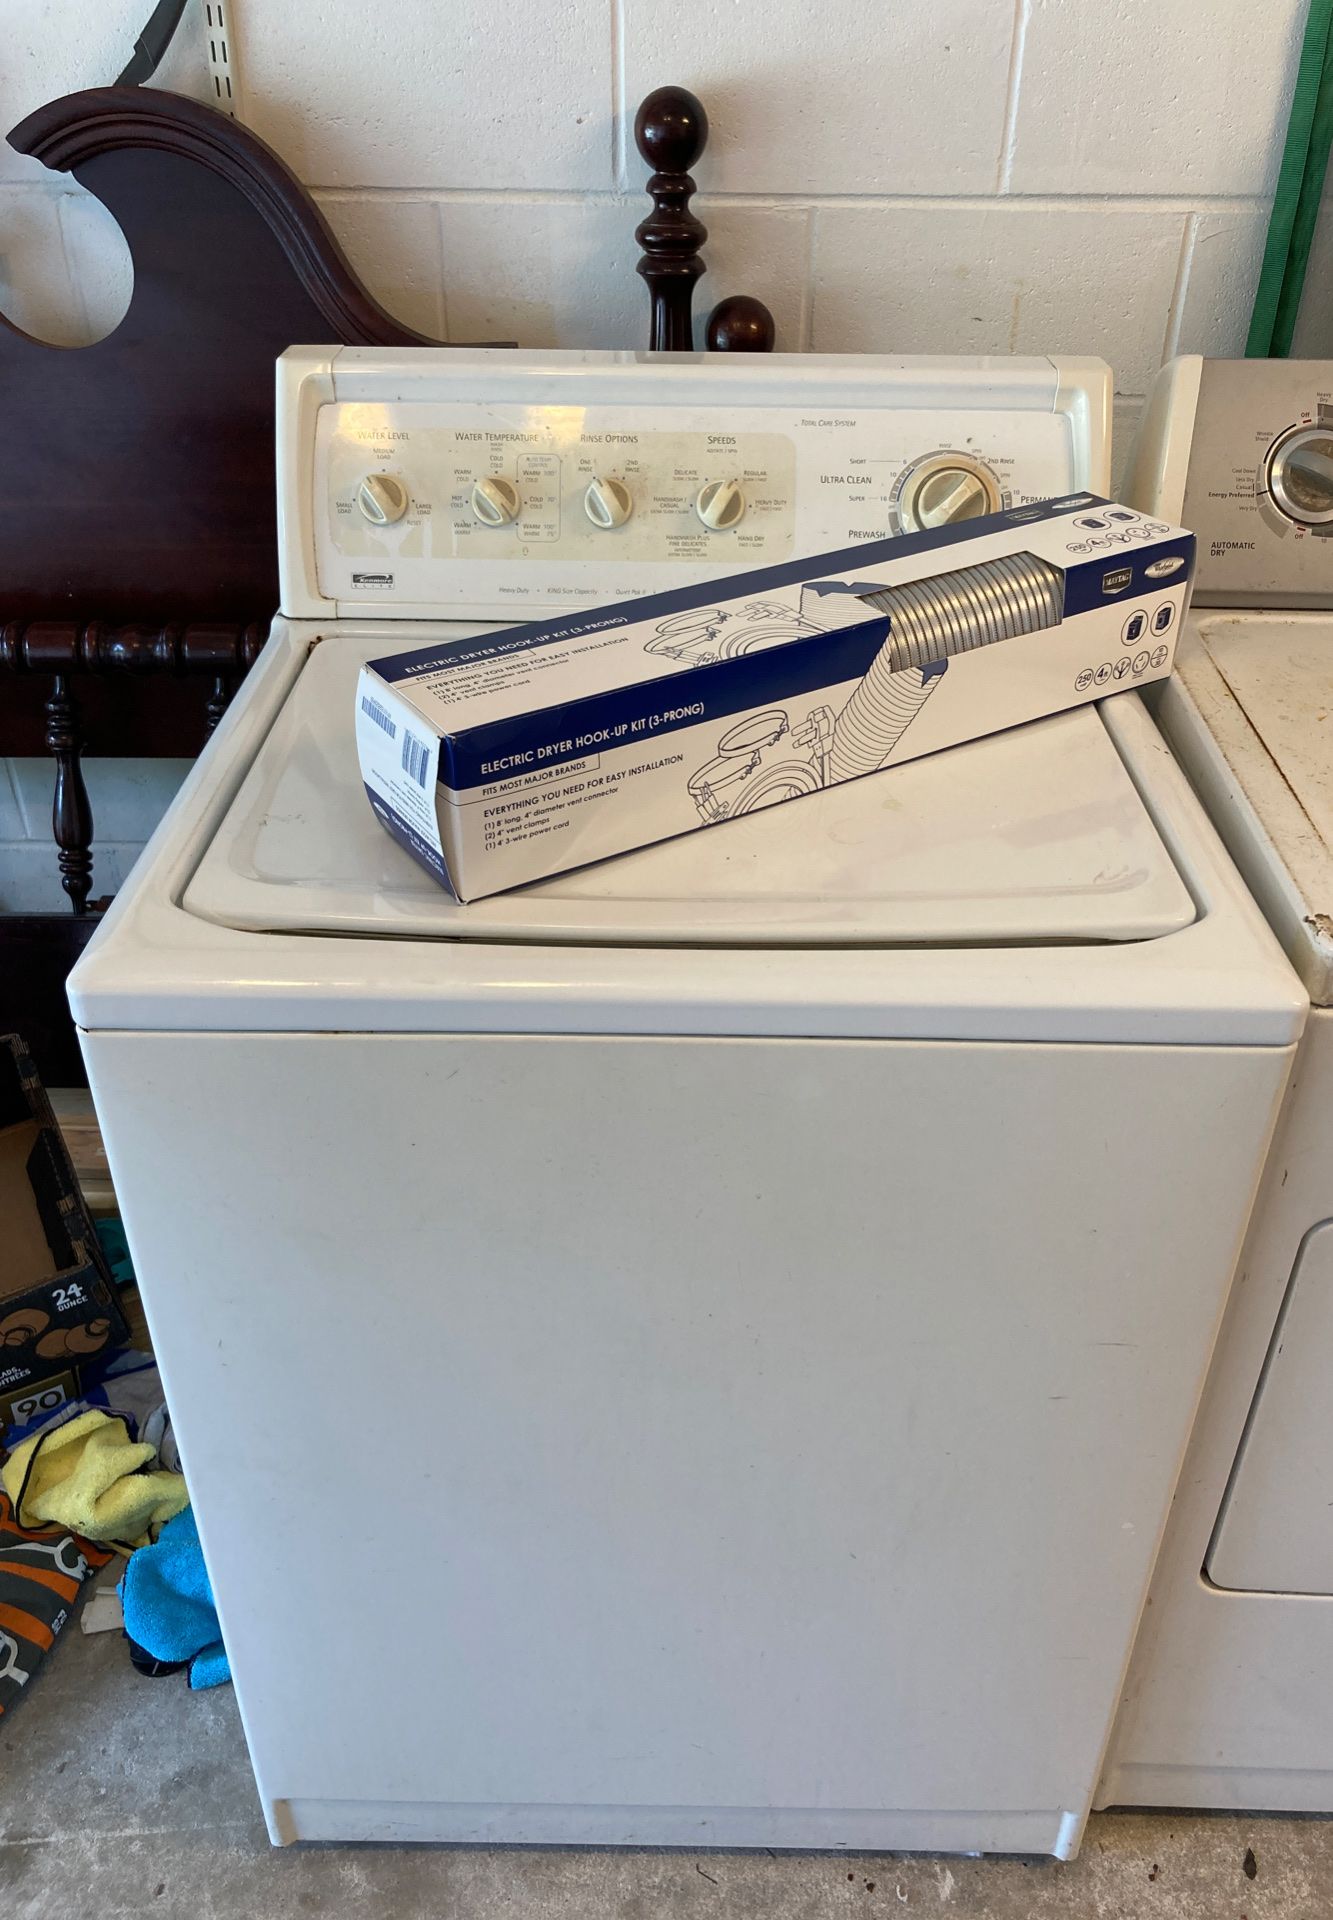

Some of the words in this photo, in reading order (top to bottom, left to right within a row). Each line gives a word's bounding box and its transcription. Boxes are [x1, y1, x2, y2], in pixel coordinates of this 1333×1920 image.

[358, 432, 386, 440] WATER
[388, 432, 410, 440] LEVEL
[455, 432, 483, 441] WATER
[485, 432, 539, 442] TEMPERATURE
[580, 434, 603, 443] RINSE
[605, 434, 639, 443] OPTIONS
[707, 435, 736, 444] SPEEDS
[820, 475, 845, 484] ULTRA
[846, 475, 872, 484] CLEAN
[1021, 495, 1055, 504] PERMA
[848, 529, 886, 539] PREWASH
[1210, 541, 1255, 550] AUTOMATIC
[1210, 549, 1226, 557] DRY
[1106, 572, 1129, 586] MAYTAG
[404, 657, 459, 673] ELECTRIC
[459, 648, 497, 660] DRYER
[498, 635, 551, 651] HOOK-UP
[552, 630, 569, 638] KIT
[570, 616, 628, 635] (3-PRONG)
[426, 673, 482, 690] EVERYTHING
[483, 668, 504, 676] YOU
[505, 662, 529, 671] NEED
[530, 657, 548, 665] FOR
[549, 652, 570, 660] EASY
[571, 637, 629, 654] INSTALLATION
[433, 669, 456, 677] MOST
[457, 663, 486, 672] MAJOR
[487, 654, 520, 665] BRANDS
[483, 672, 515, 683] diameter
[533, 659, 569, 671] connector
[477, 681, 505, 690] clamps
[488, 684, 512, 694] power
[513, 679, 531, 687] cord
[1078, 673, 1092, 685] 250
[481, 751, 534, 774] ELECTRIC
[537, 739, 573, 759] DRYER
[575, 724, 628, 748] HOOK-UP
[631, 718, 647, 732] KIT
[648, 702, 705, 730] (3-PRONG)
[482, 786, 498, 796] FITS
[499, 779, 522, 792] MOST
[524, 771, 554, 786] MAJOR
[555, 761, 587, 777] BRANDS
[484, 796, 539, 818] EVERYTHING
[541, 790, 561, 802] YOU
[563, 783, 585, 796] NEED
[587, 777, 604, 789] FOR
[606, 771, 627, 784] EASY
[628, 754, 684, 777] INSTALLATION
[484, 821, 495, 831] (1)
[533, 803, 566, 817] diameter
[567, 796, 583, 806] vent
[583, 787, 619, 802] connector
[484, 832, 496, 841] (2)
[506, 825, 523, 834] vent
[523, 817, 550, 829] clamps
[485, 842, 496, 851] (1)
[505, 833, 527, 845] 3-wire
[529, 826, 552, 838] power
[553, 820, 570, 830] cord
[52, 1283, 83, 1307] 24
[57, 1295, 89, 1312] OUNCE
[17, 1390, 62, 1417] 90
